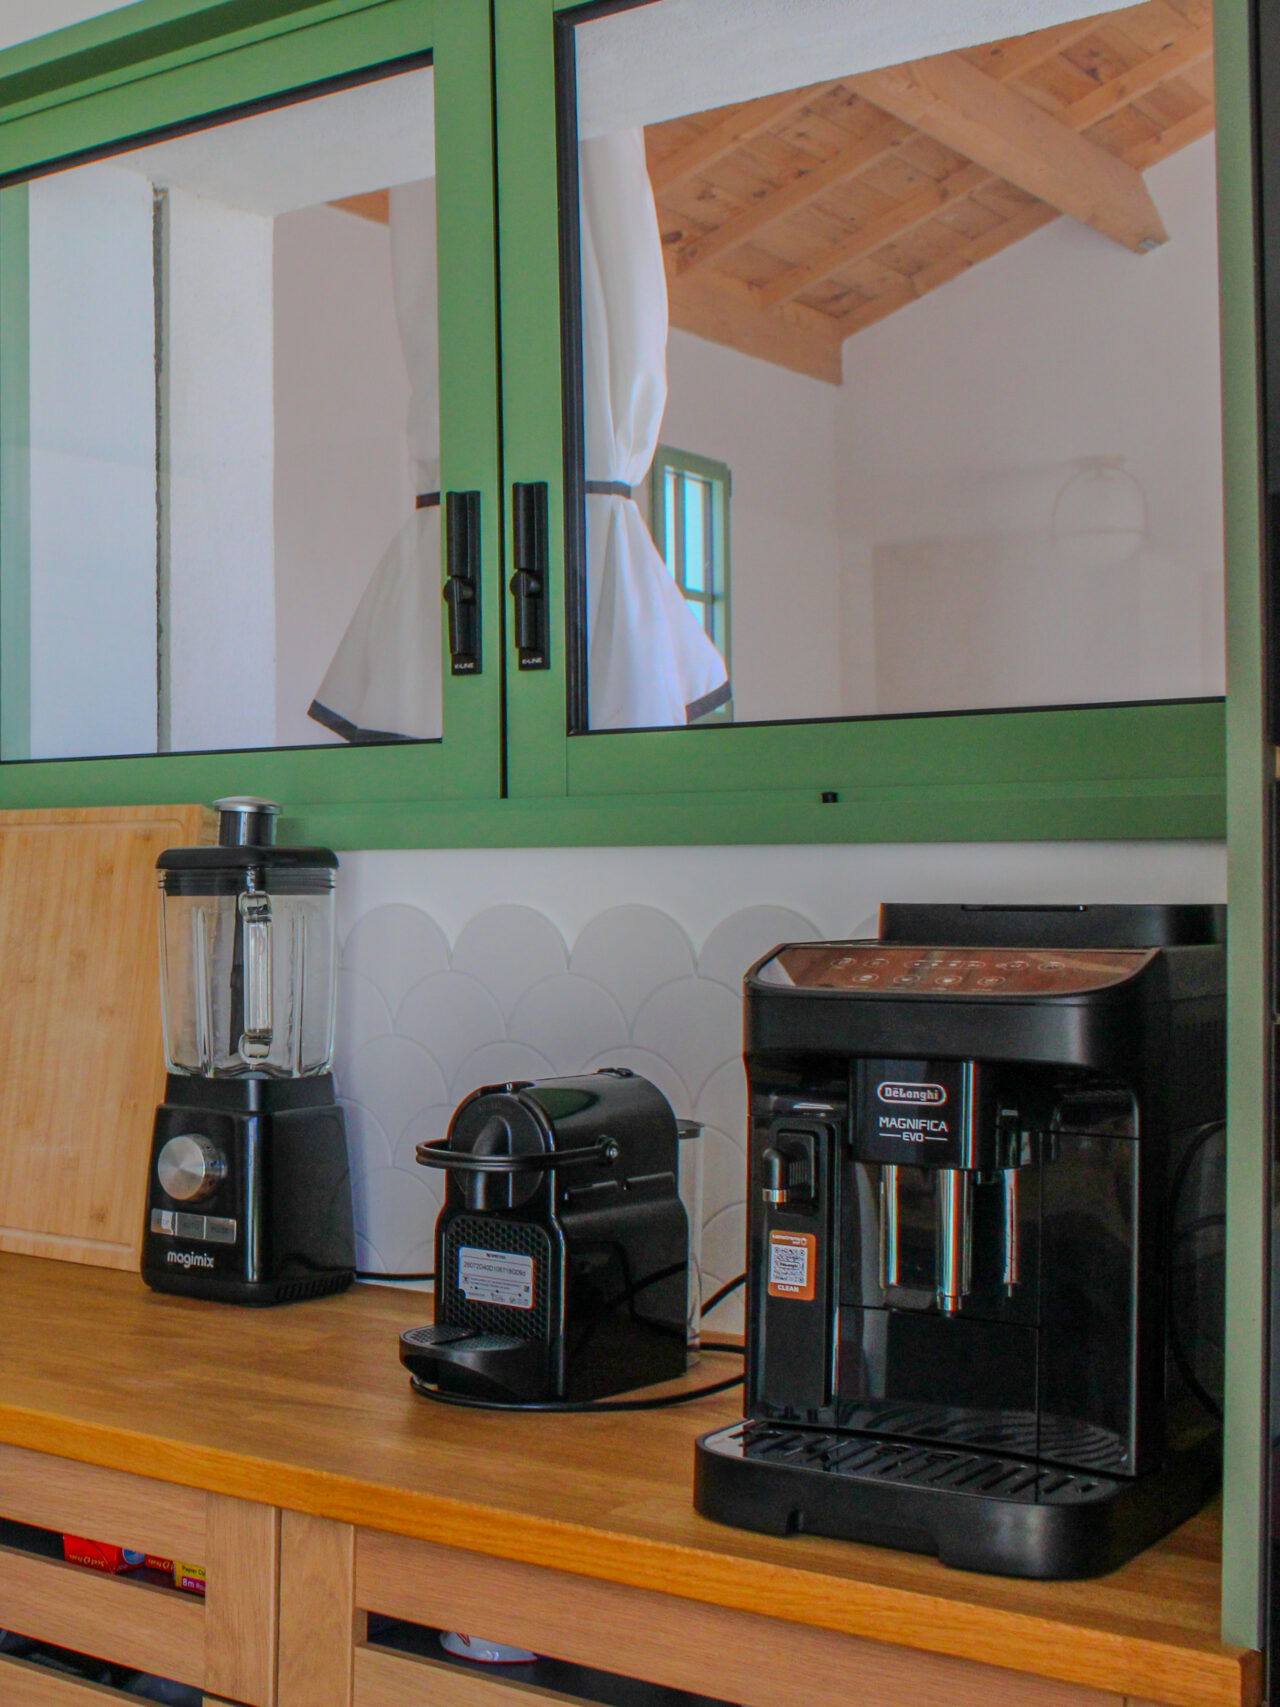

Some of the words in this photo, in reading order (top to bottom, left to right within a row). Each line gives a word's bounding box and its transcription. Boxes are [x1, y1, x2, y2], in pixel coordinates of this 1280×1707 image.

[879, 1116, 949, 1133] MAGNIFICA
[902, 1131, 924, 1142] EVO
[167, 1251, 215, 1269] magimix
[777, 1284, 799, 1293] CLEAN
[183, 1577, 195, 1588] 8m
